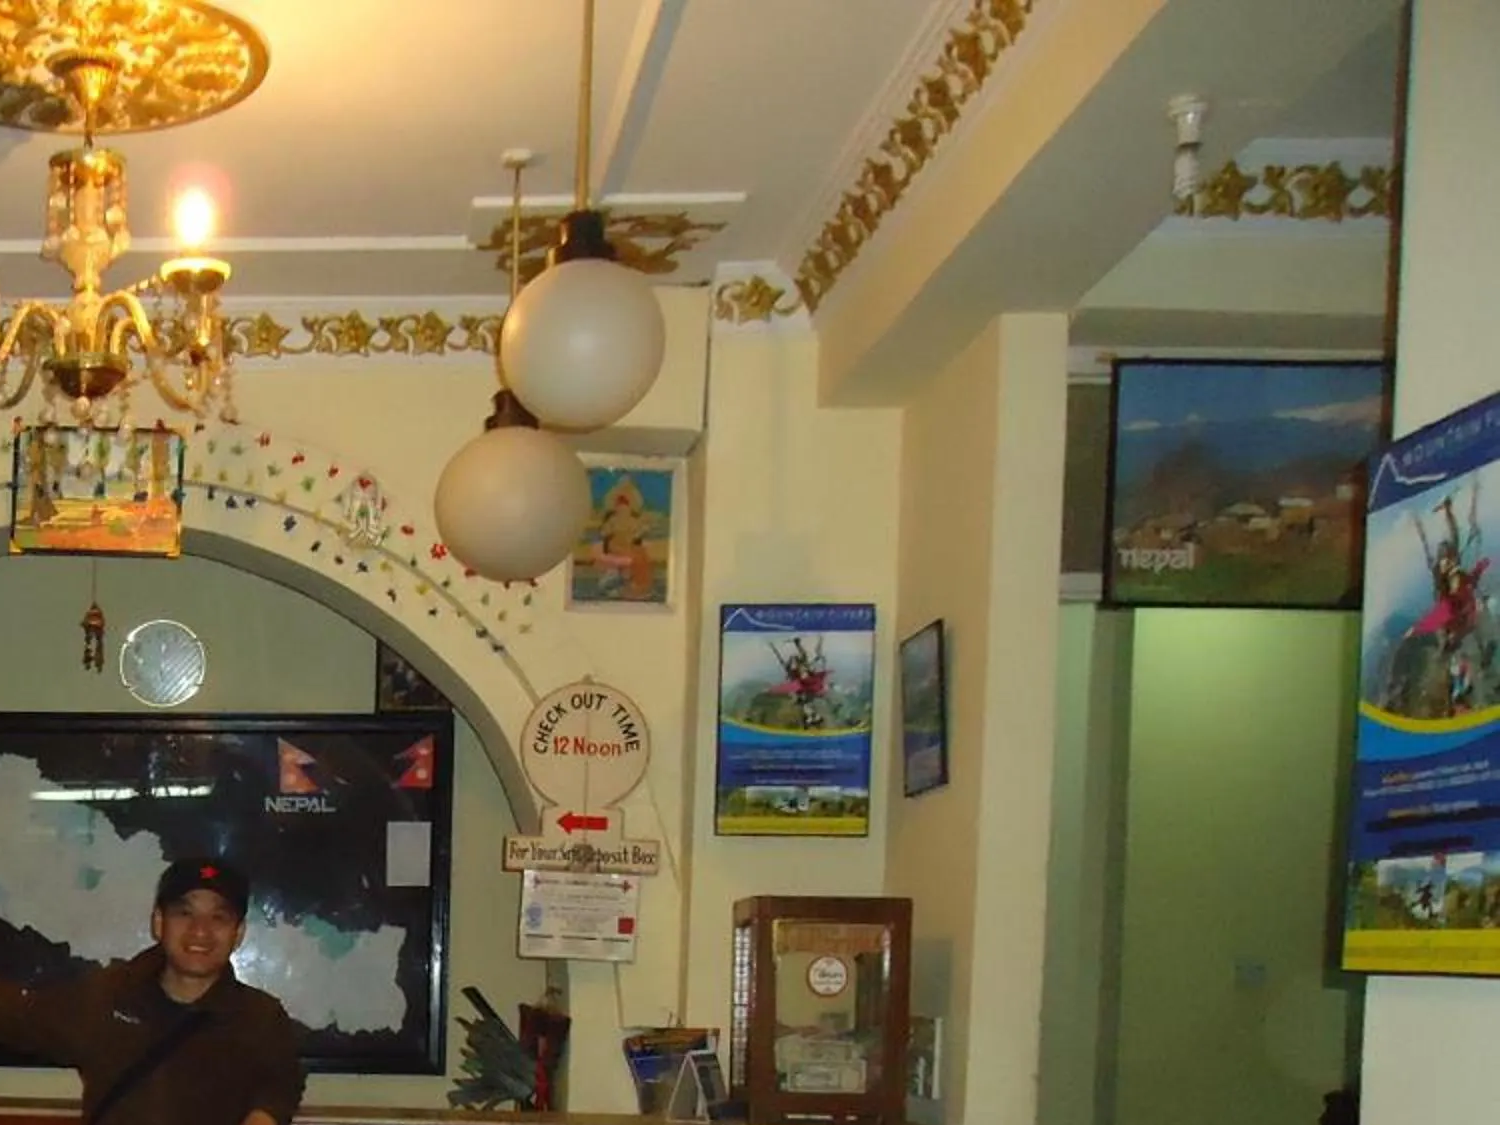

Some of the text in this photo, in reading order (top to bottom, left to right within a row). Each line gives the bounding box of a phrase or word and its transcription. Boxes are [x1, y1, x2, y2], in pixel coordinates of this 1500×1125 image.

[1117, 542, 1195, 575] nepal
[533, 692, 640, 754] CHECK OUT TIME
[553, 736, 621, 756] 12 Noon
[264, 796, 337, 813] NEPAL
